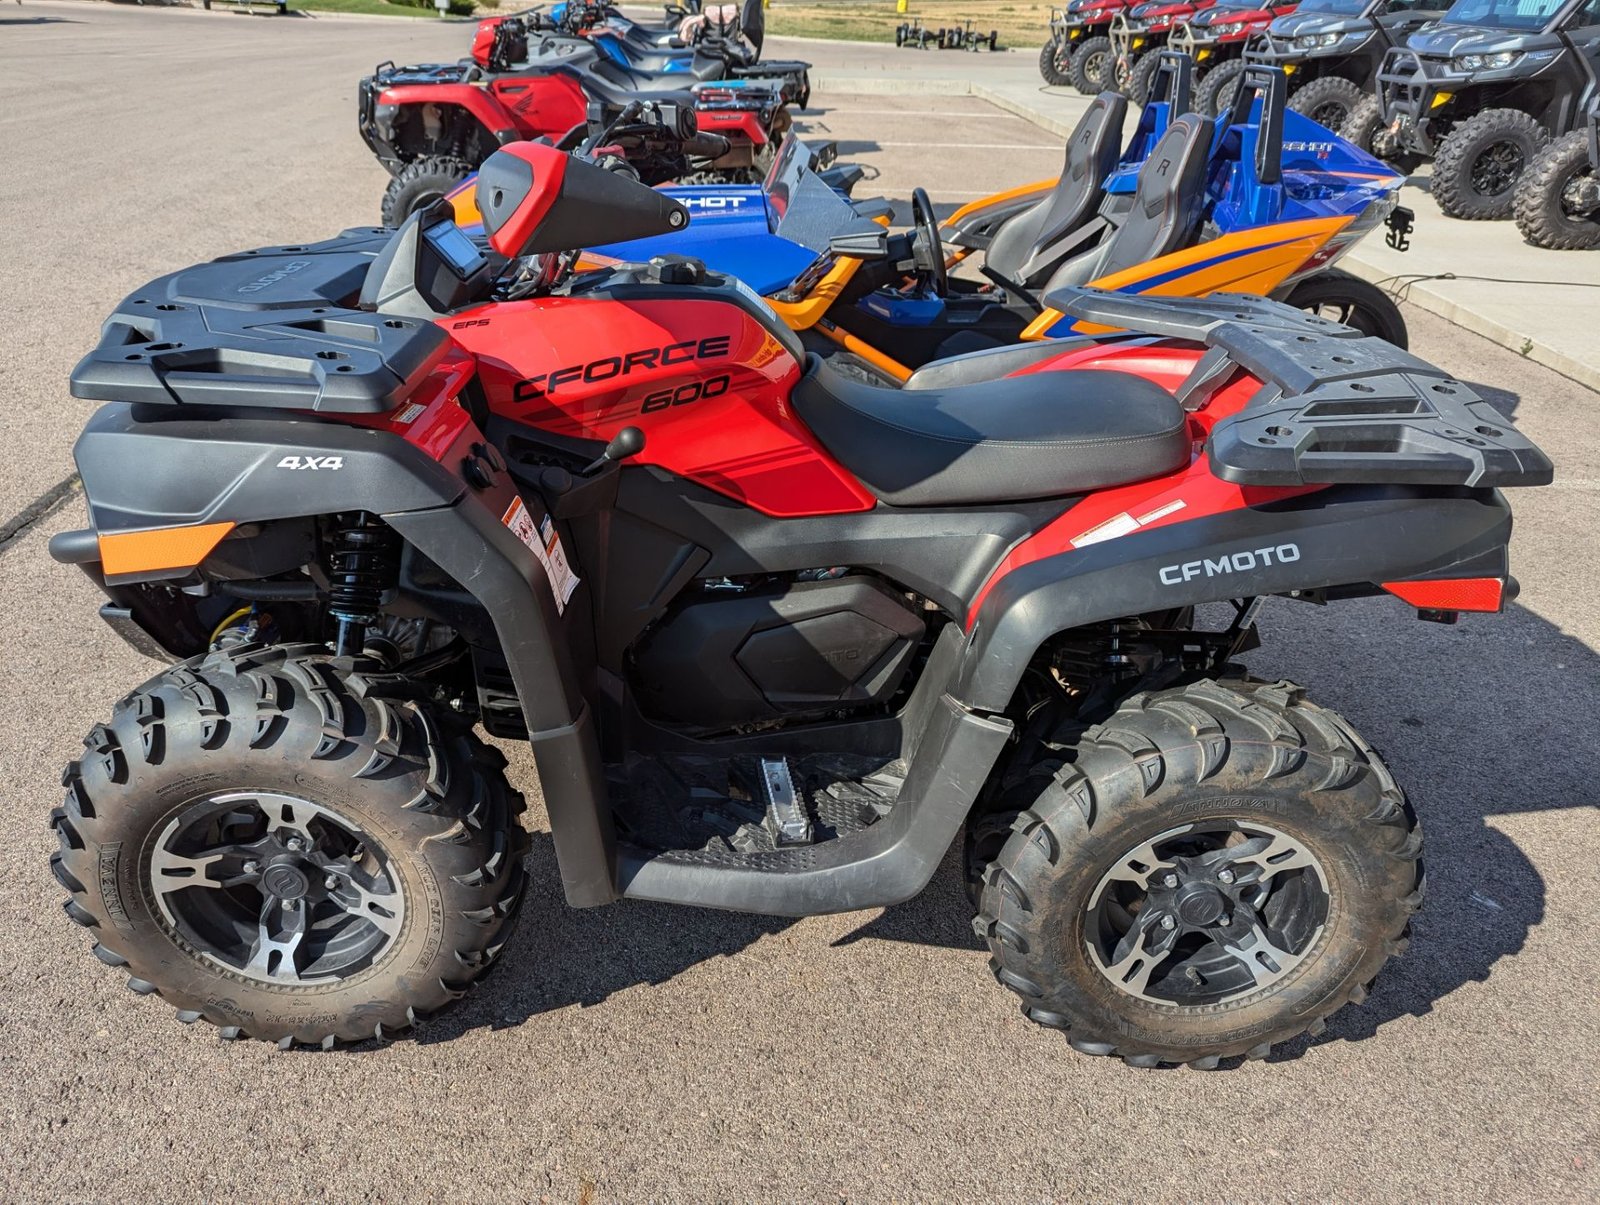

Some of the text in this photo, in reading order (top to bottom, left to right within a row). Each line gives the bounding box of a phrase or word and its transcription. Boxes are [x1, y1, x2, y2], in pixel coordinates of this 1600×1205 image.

[1157, 159, 1171, 176] R
[453, 319, 491, 330] EPS
[513, 336, 731, 404] CFORCE
[641, 375, 731, 414] 600
[276, 456, 343, 470] 4X4
[1159, 543, 1300, 585] CFMOTO
